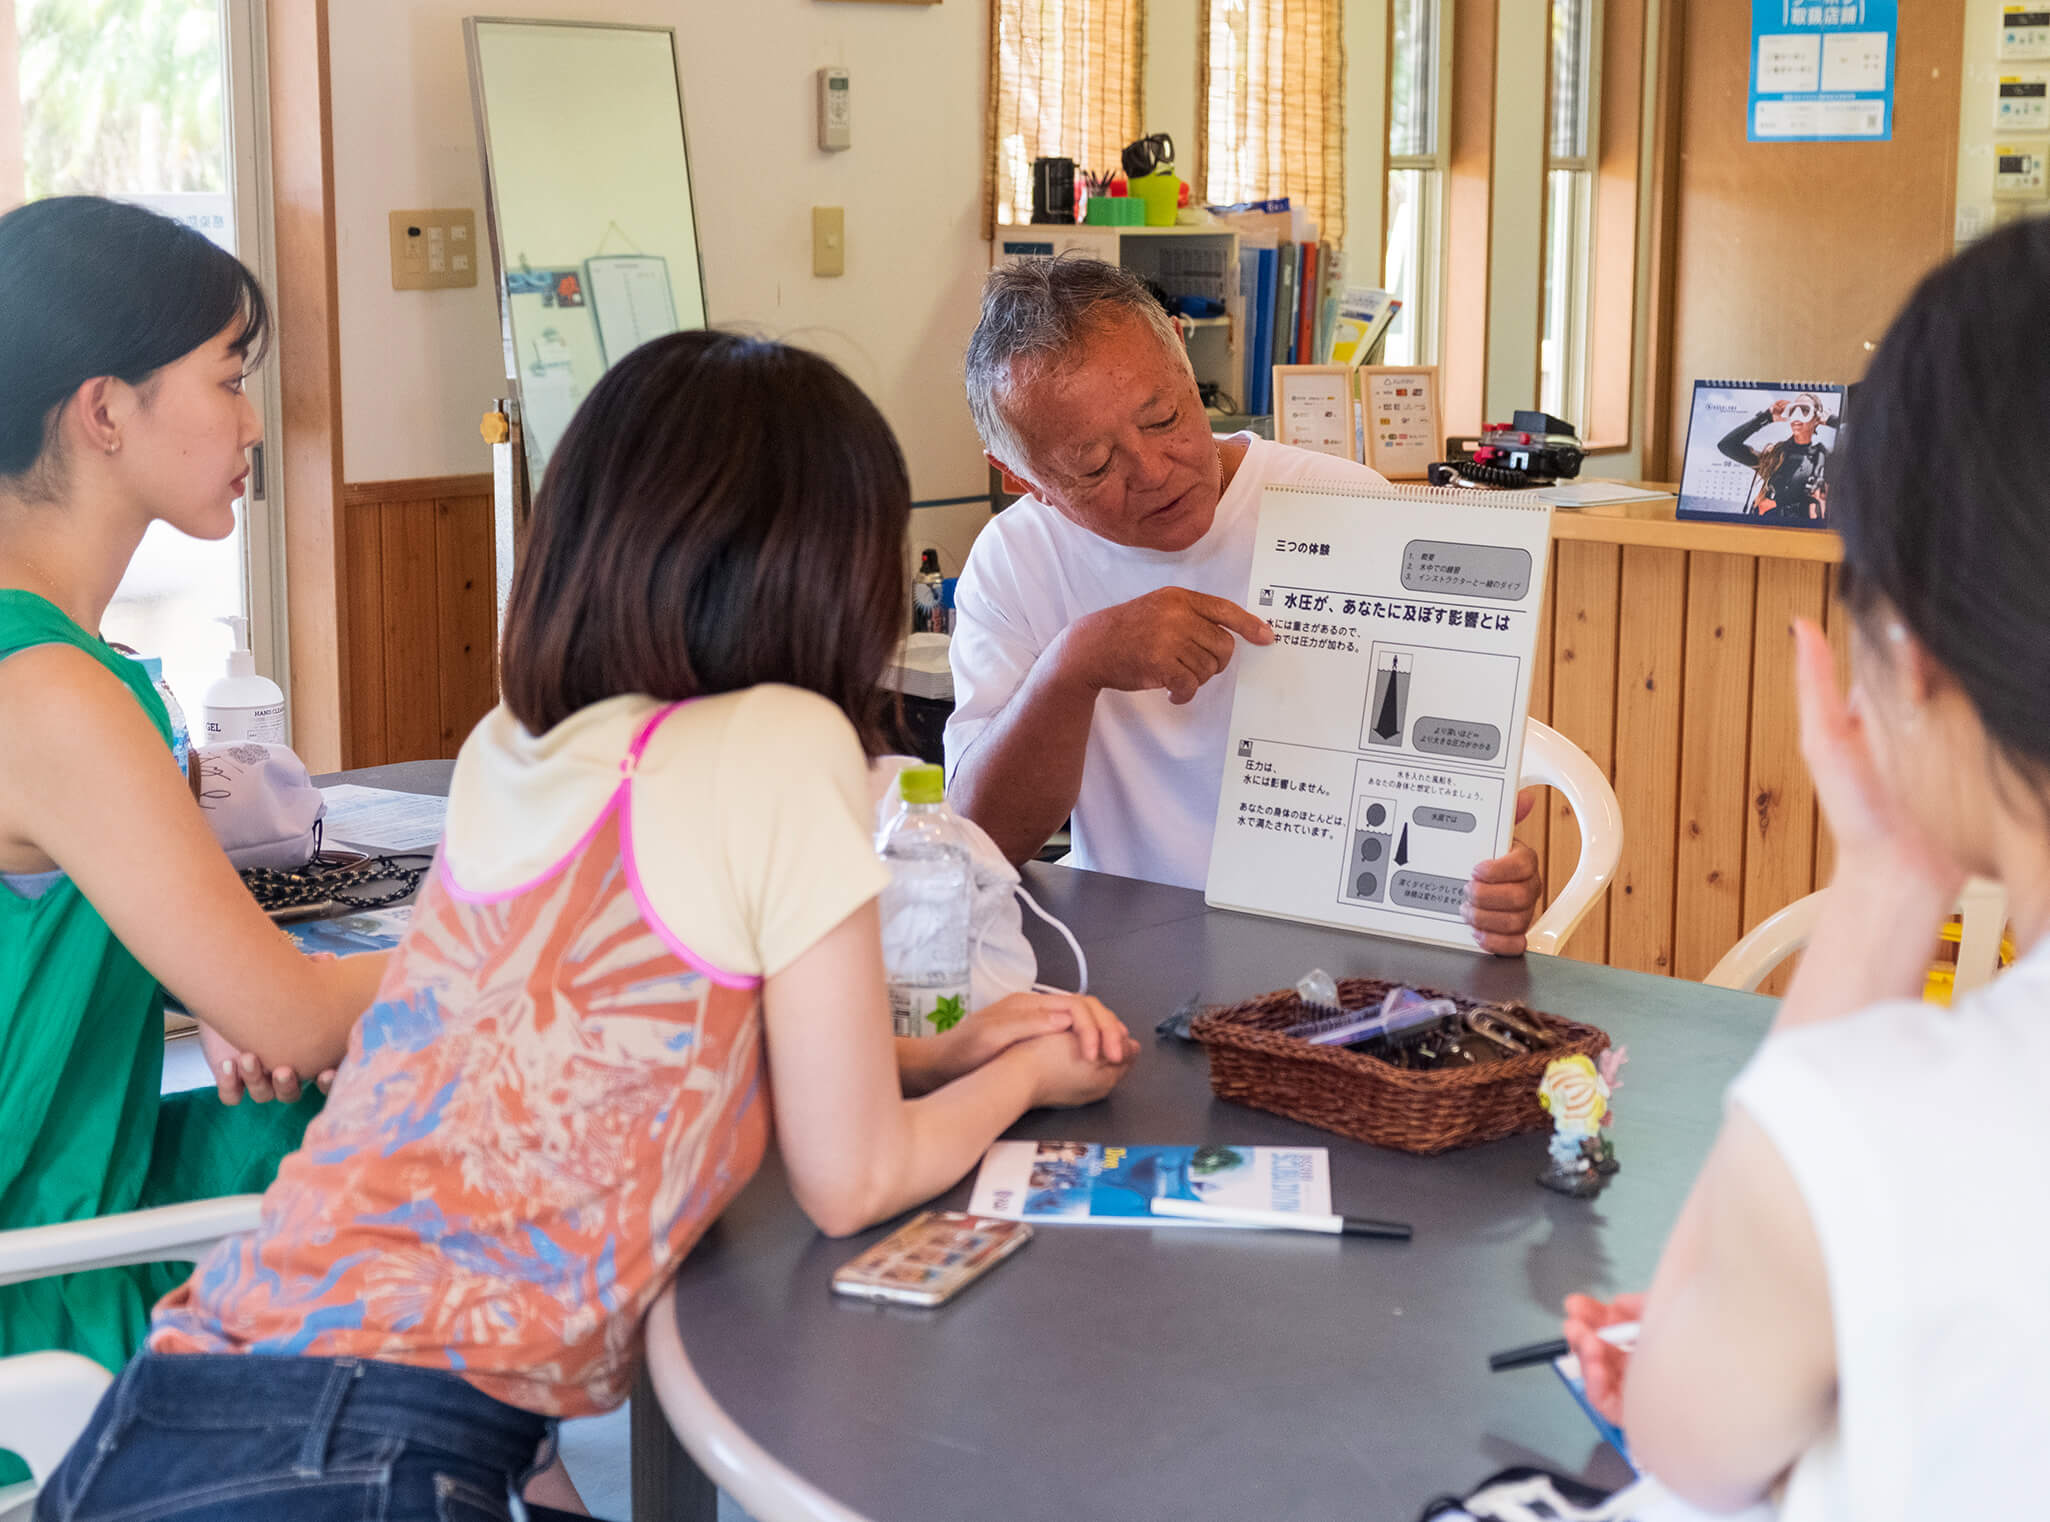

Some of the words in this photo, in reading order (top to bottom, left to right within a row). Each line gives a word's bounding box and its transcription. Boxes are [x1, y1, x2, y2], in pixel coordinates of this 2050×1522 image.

[1275, 539, 1330, 556] 三つの体験
[1284, 593, 1510, 631] 水圧が、あなたに及ぼす影響とは
[1273, 633, 1359, 654] 中では圧力が加わる。
[1245, 759, 1277, 774] 圧力は、
[1243, 774, 1330, 796] 水には影響しません。
[1240, 802, 1346, 827] あなたの身体のほとんどは、
[1237, 816, 1333, 840] 水で満たされています。
